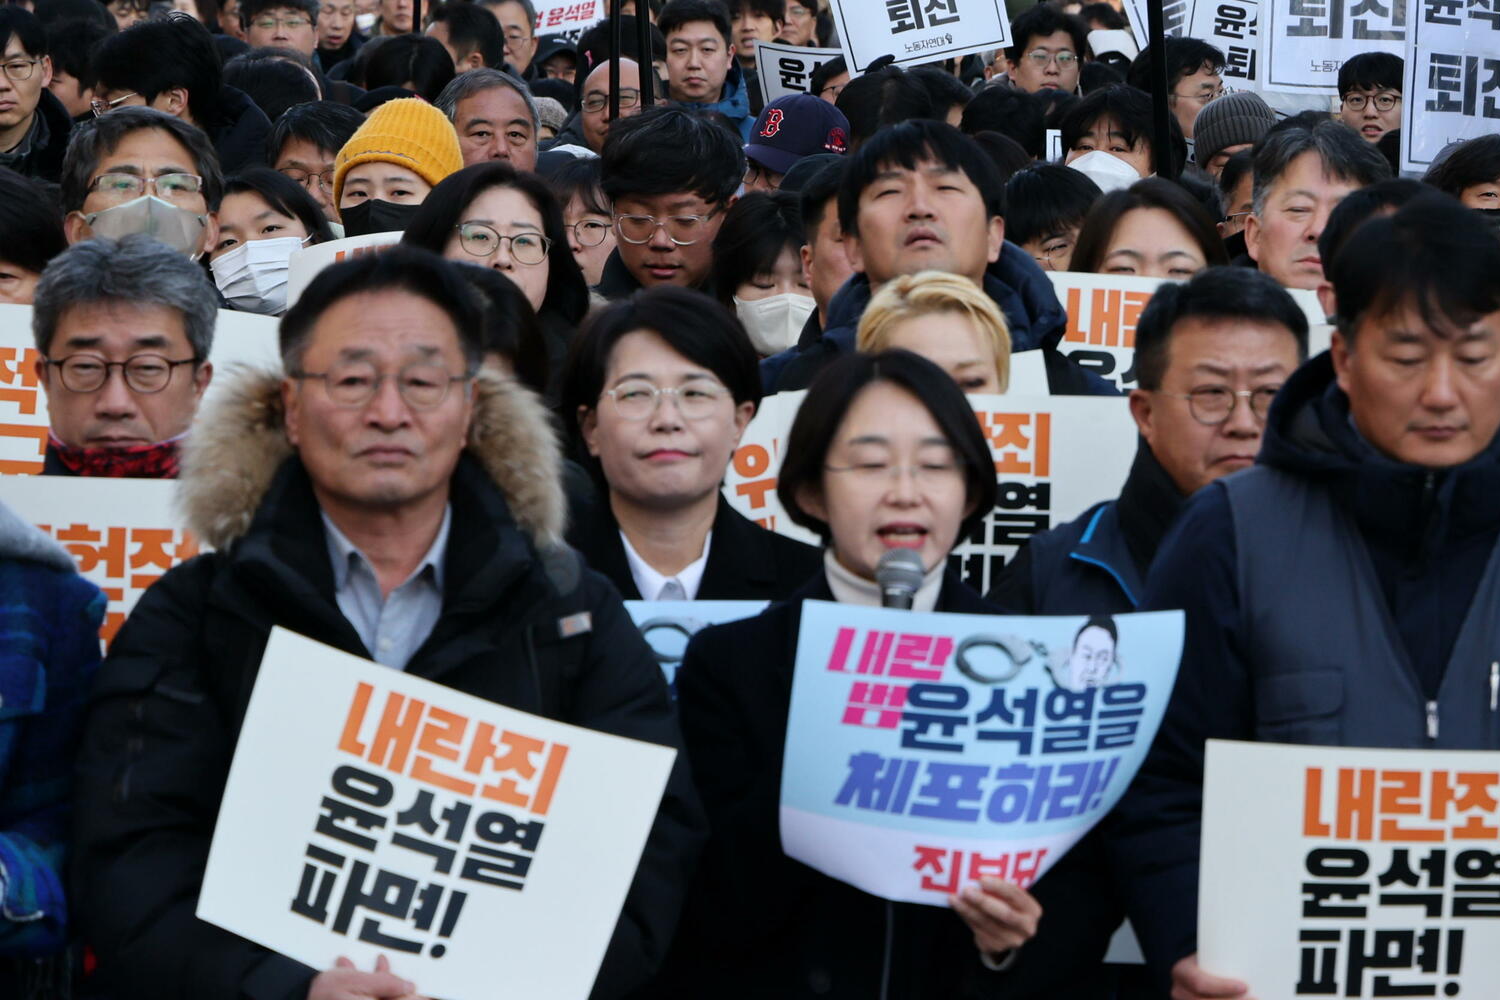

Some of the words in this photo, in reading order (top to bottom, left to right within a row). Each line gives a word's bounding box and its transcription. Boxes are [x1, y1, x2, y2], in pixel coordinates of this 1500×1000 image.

[826, 626, 954, 681] 내란
[337, 682, 570, 817] 내란죄
[901, 682, 1147, 757] 윤석열을
[834, 751, 1121, 825] 체포하라!
[314, 764, 546, 891] 윤석열
[290, 844, 468, 960] 파면!
[1296, 927, 1465, 998] 파면!
